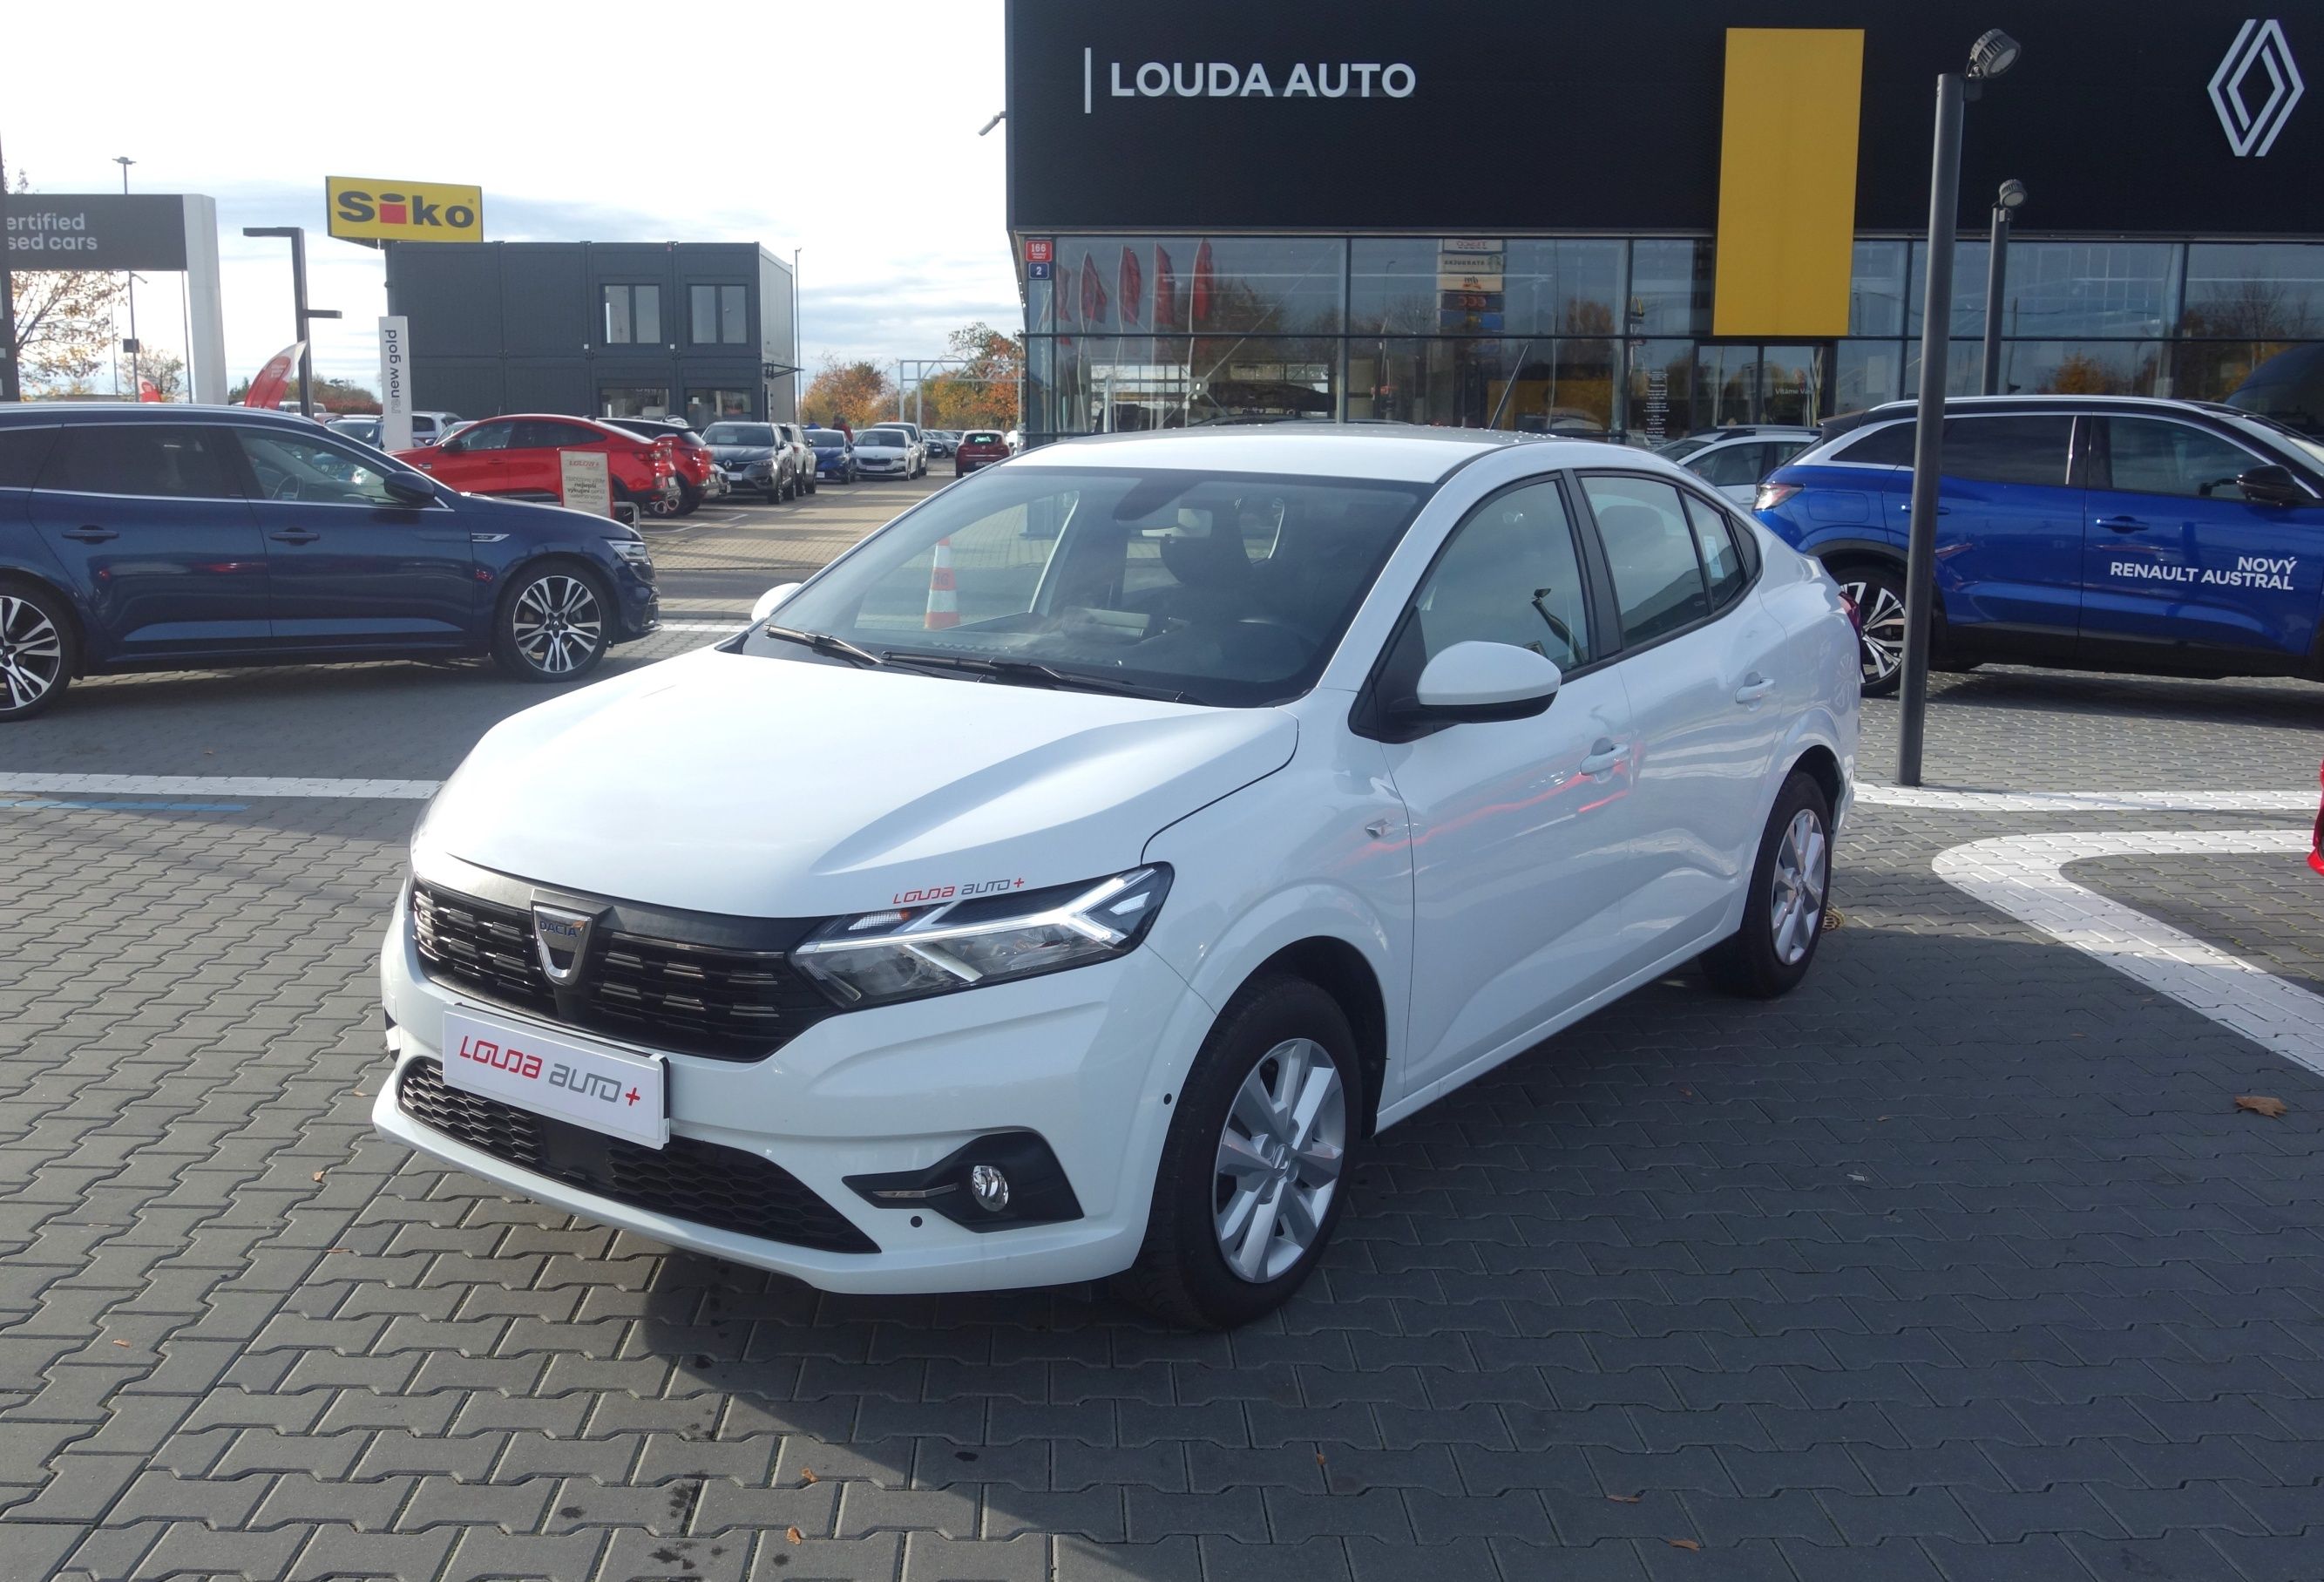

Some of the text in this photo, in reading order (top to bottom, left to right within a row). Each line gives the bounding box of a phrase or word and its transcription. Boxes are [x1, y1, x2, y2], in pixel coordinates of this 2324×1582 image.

[1111, 62, 1417, 98] LOUDA AUTO
[7, 213, 85, 231] ertified
[8, 233, 98, 250] sed cars
[1031, 243, 1047, 253] 166
[1036, 266, 1042, 275] 2
[385, 329, 402, 364] gold
[2238, 556, 2298, 575] NOVÝ
[2110, 561, 2294, 591] RENAULT AUSTRAL
[539, 920, 578, 938] DACIA
